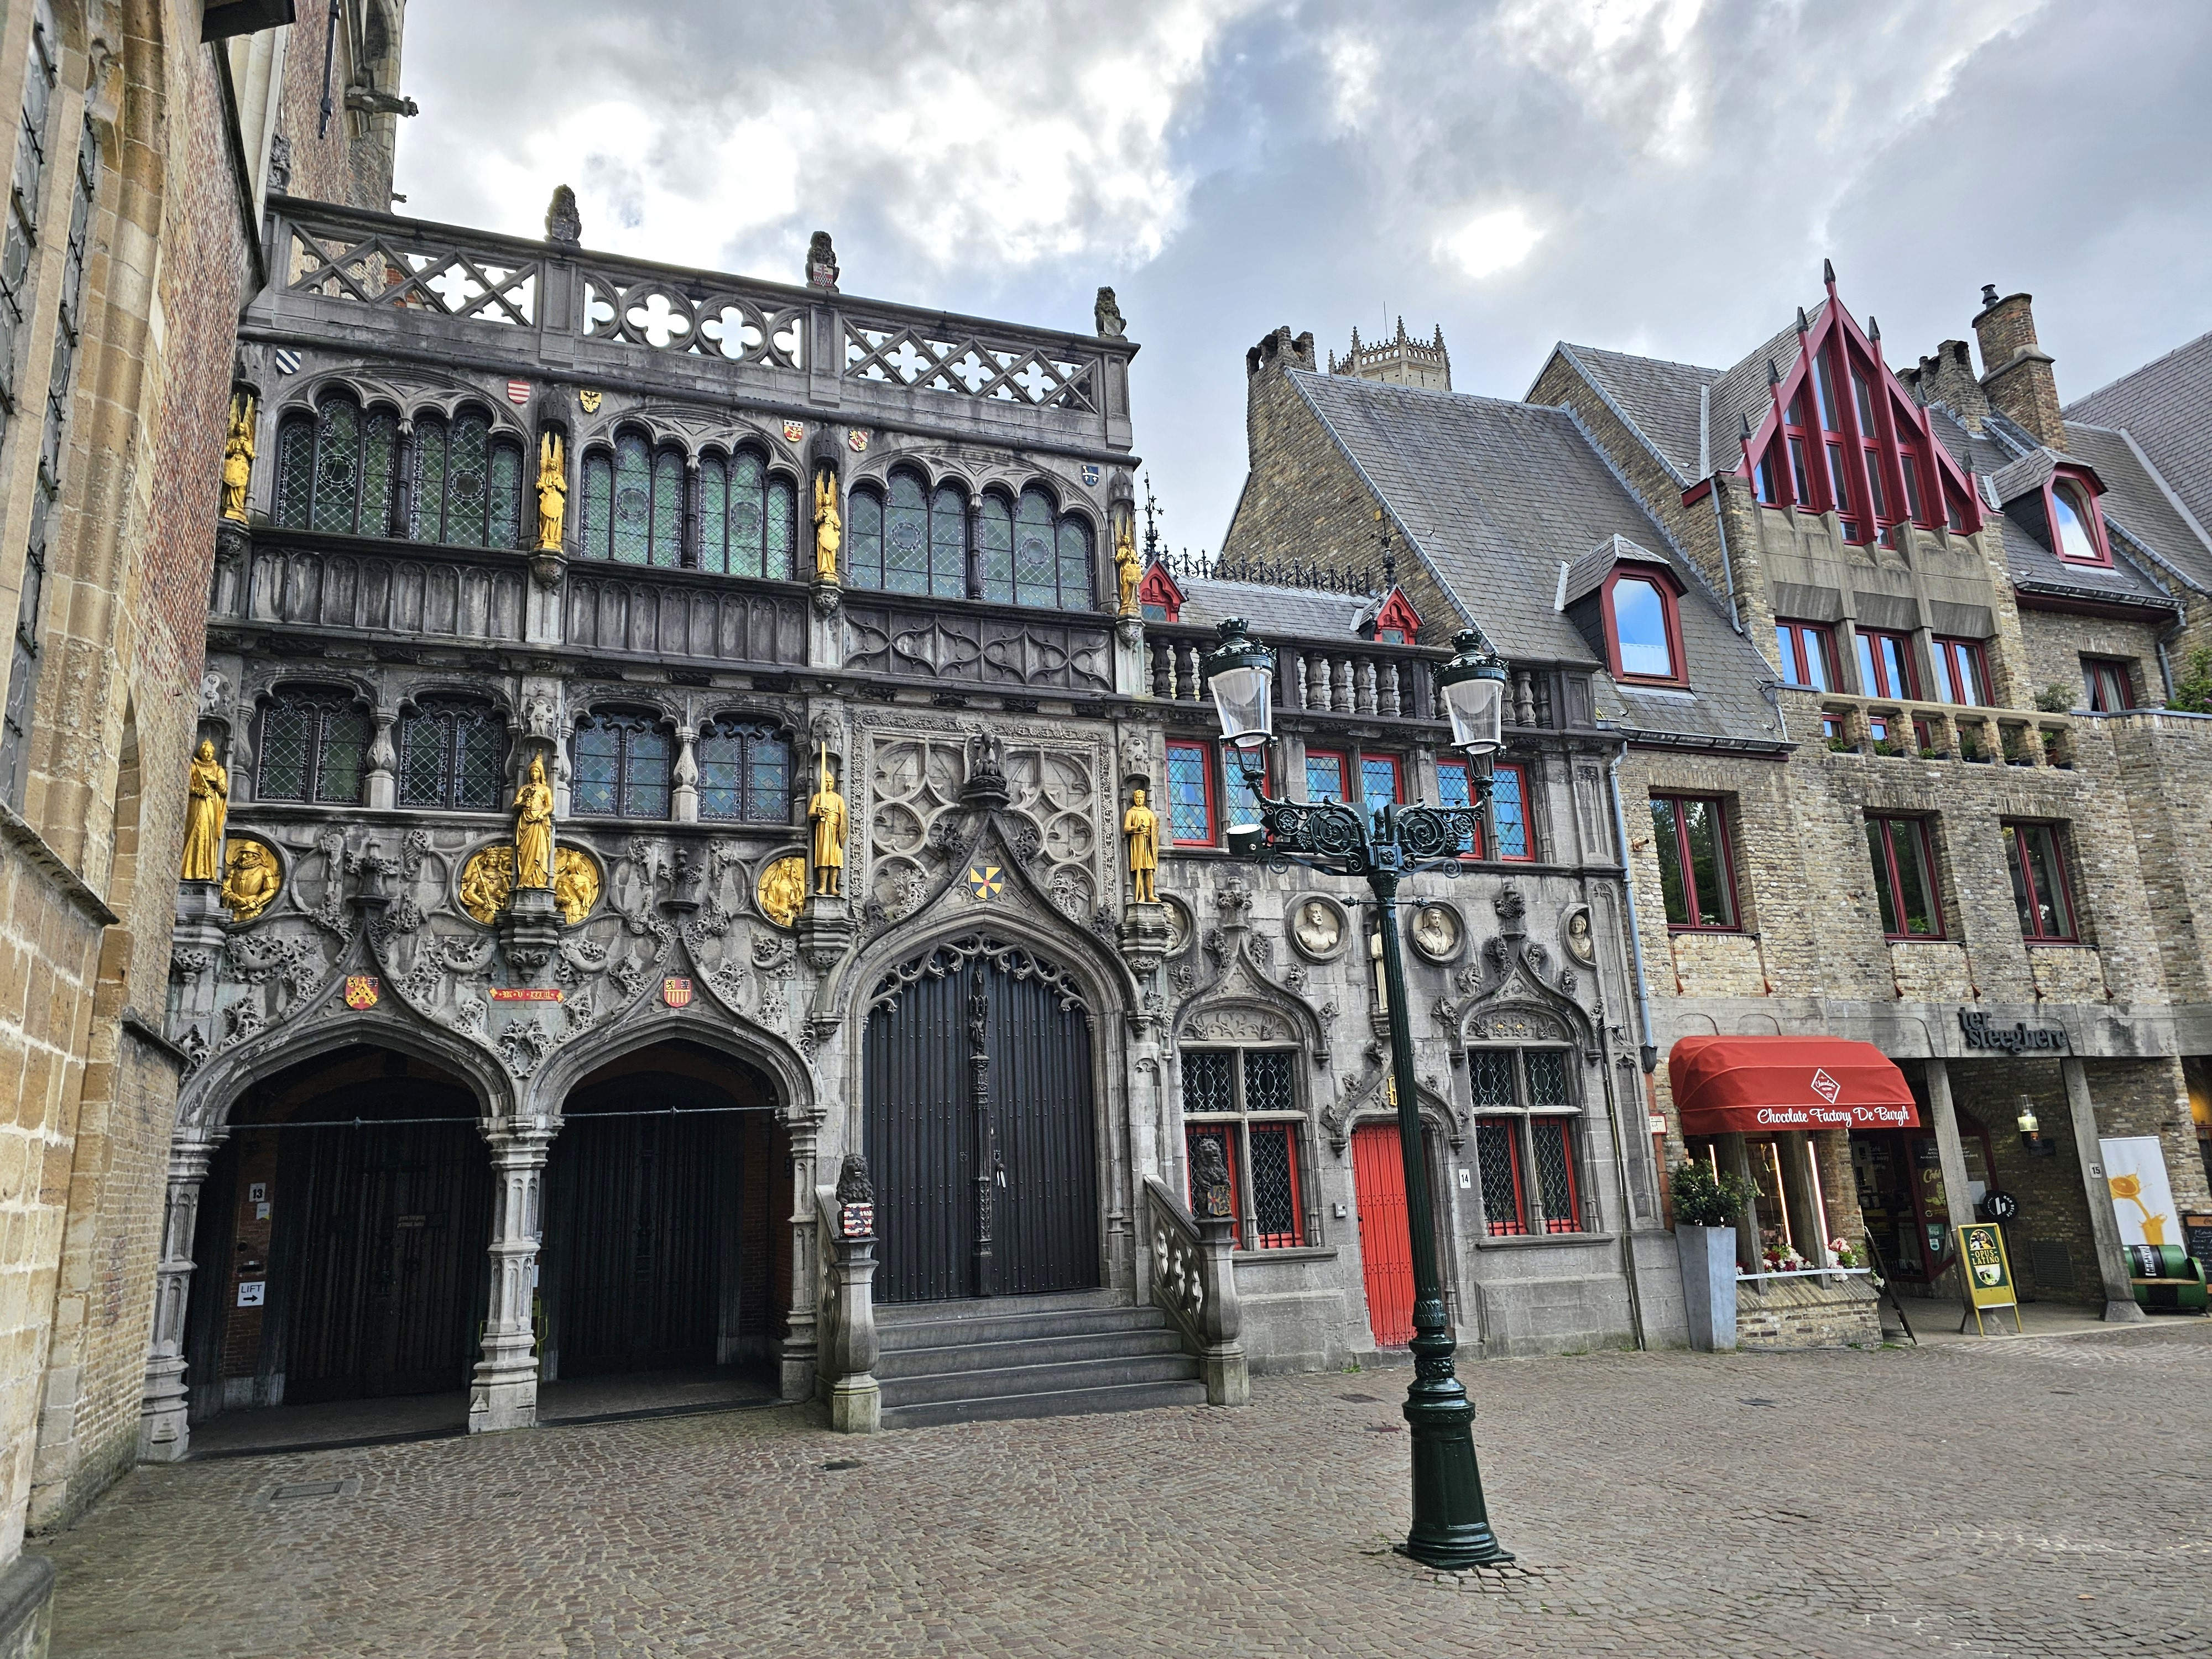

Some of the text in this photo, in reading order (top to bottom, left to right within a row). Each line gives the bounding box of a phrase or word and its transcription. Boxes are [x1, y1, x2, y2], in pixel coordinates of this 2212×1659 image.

[1958, 1007, 1992, 1031] ter
[1966, 1022, 2068, 1053] steeghere
[1757, 1106, 1910, 1127] Chocolate Factory De Burgh
[1461, 1174, 1469, 1183] 14
[253, 1188, 263, 1199] 13
[1972, 1256, 2000, 1265] LATINO
[241, 1285, 263, 1293] LIFT
